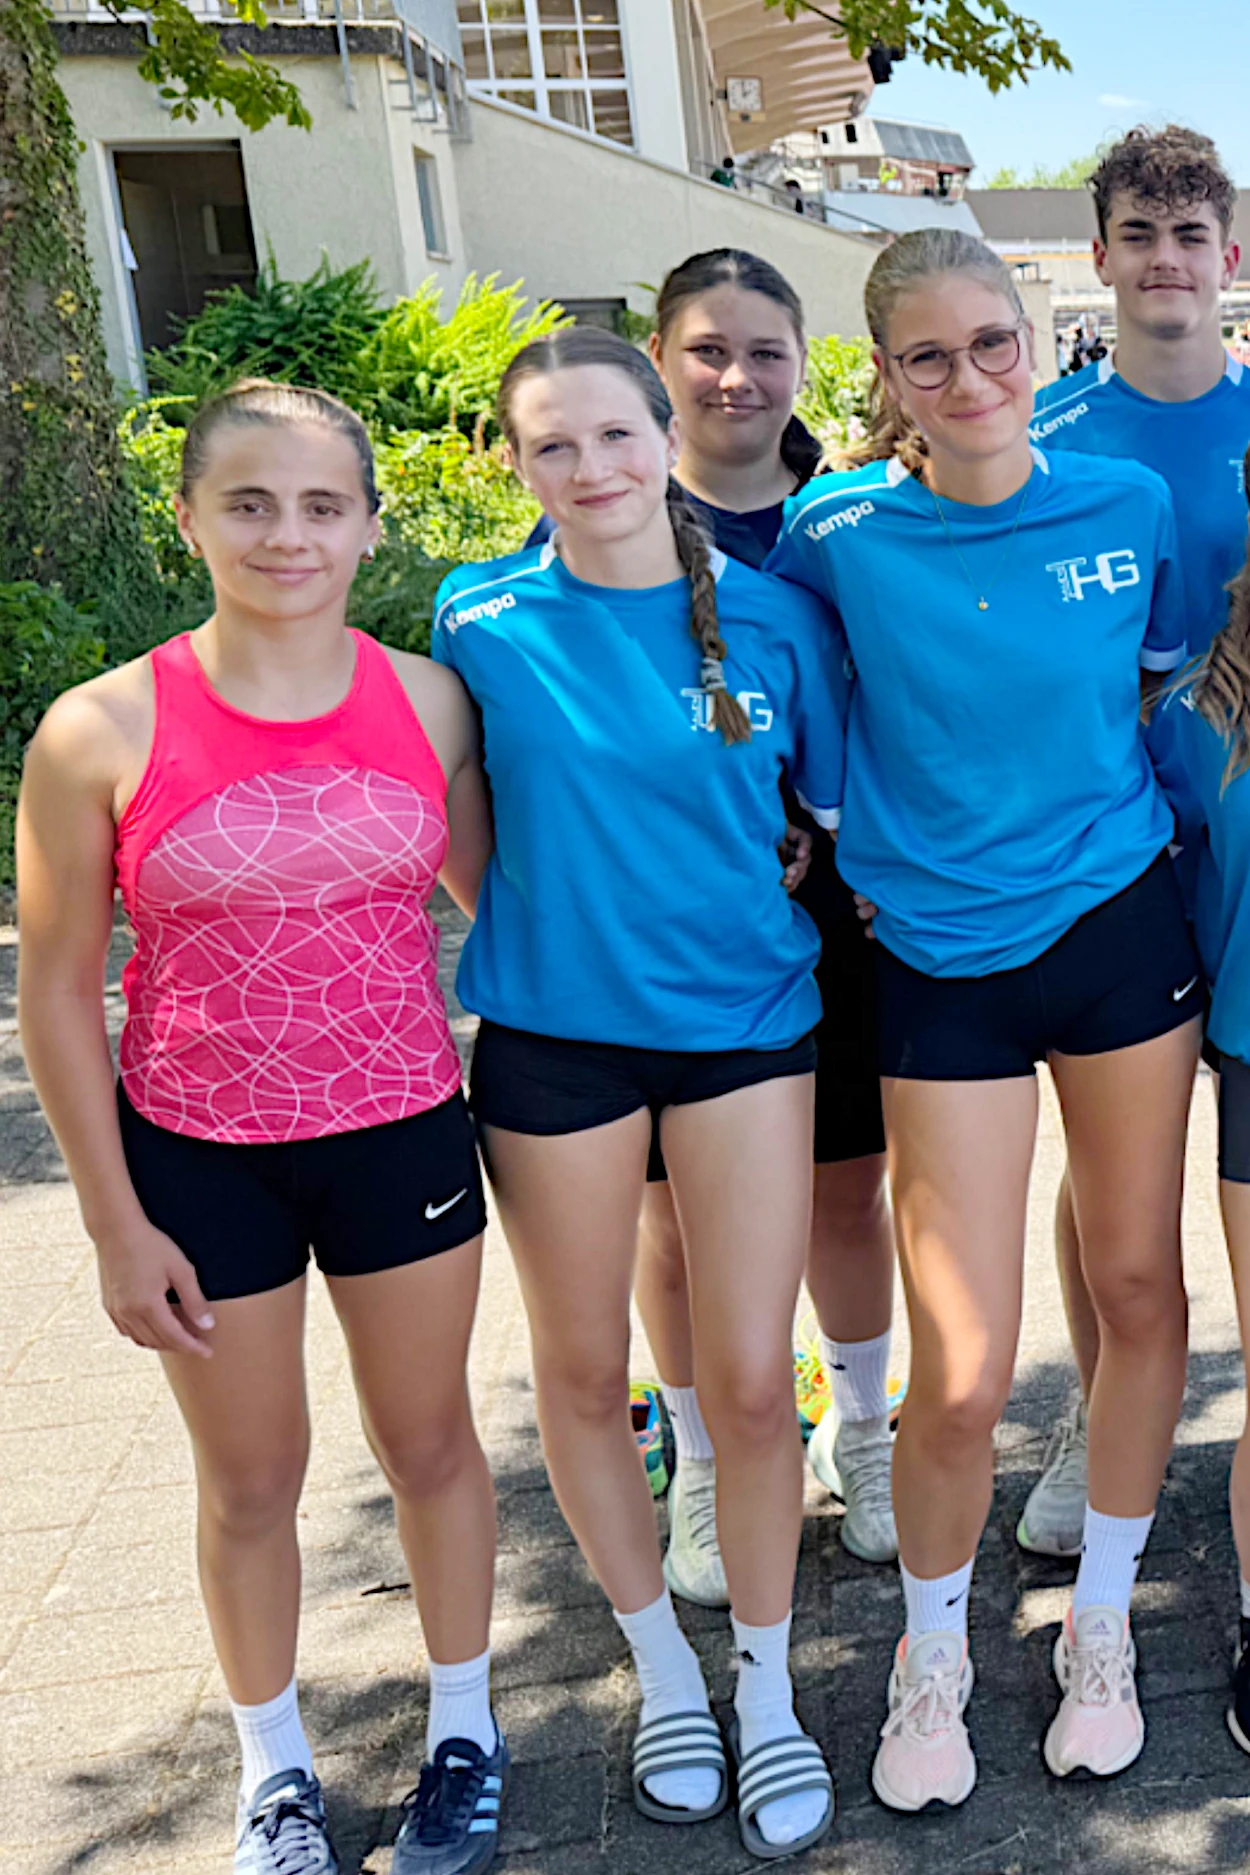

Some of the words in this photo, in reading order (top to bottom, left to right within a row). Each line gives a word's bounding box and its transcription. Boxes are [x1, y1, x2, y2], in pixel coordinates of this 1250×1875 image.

[1027, 402, 1090, 442] Kempa
[803, 499, 876, 544] Kempa
[1045, 549, 1140, 602] THG
[444, 591, 517, 635] Kempa
